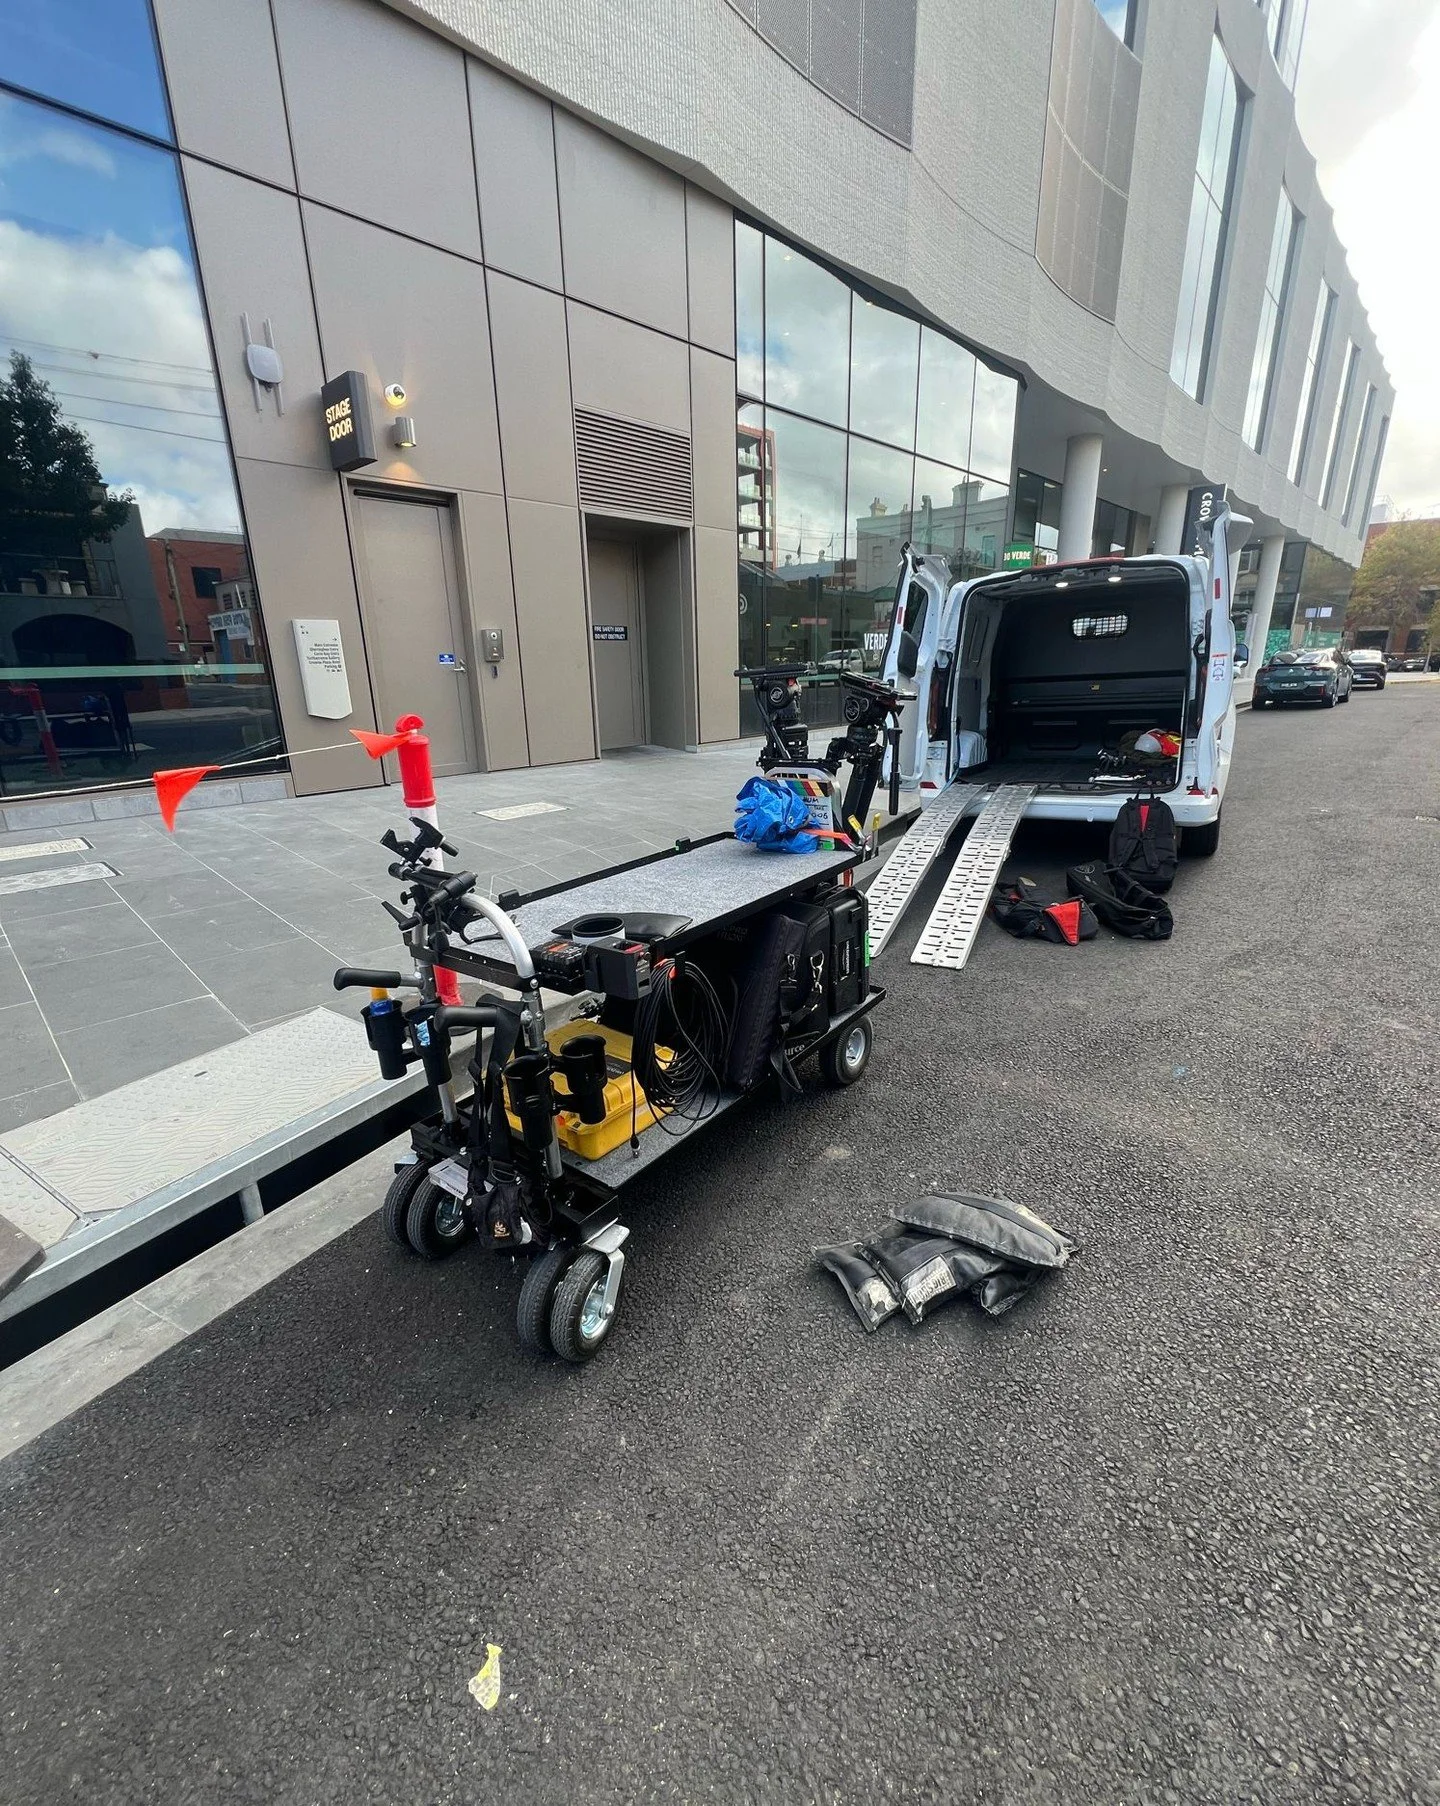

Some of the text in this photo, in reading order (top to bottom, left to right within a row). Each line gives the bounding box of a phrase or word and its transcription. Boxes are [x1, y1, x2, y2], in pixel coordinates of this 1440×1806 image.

[325, 397, 351, 424] STAGE
[329, 417, 353, 441] DOOR
[1011, 551, 1031, 560] VERDE
